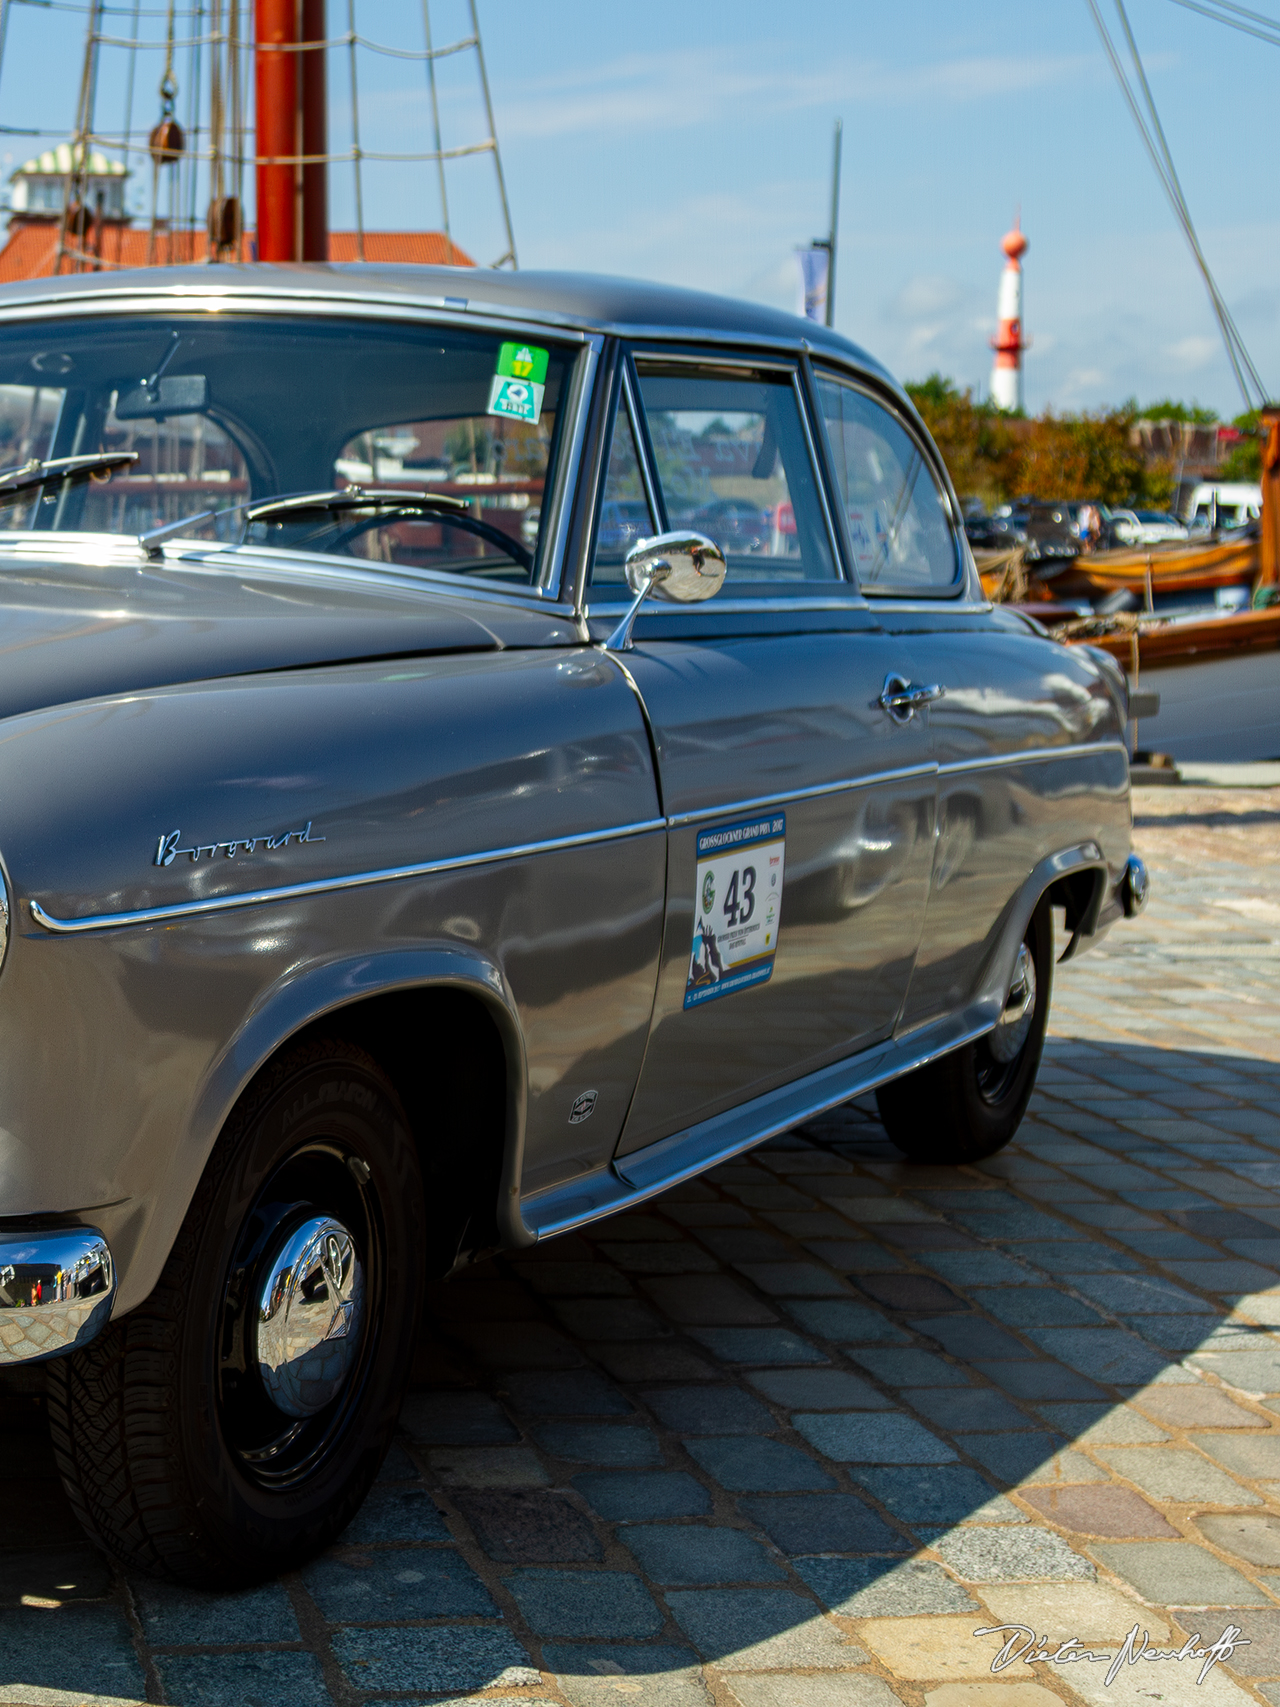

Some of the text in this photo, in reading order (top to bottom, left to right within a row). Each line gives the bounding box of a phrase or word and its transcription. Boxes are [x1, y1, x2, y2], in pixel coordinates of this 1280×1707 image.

[512, 361, 534, 377] 17
[153, 820, 327, 867] Borgward
[742, 822, 760, 840] GRAND
[723, 865, 757, 928] 43
